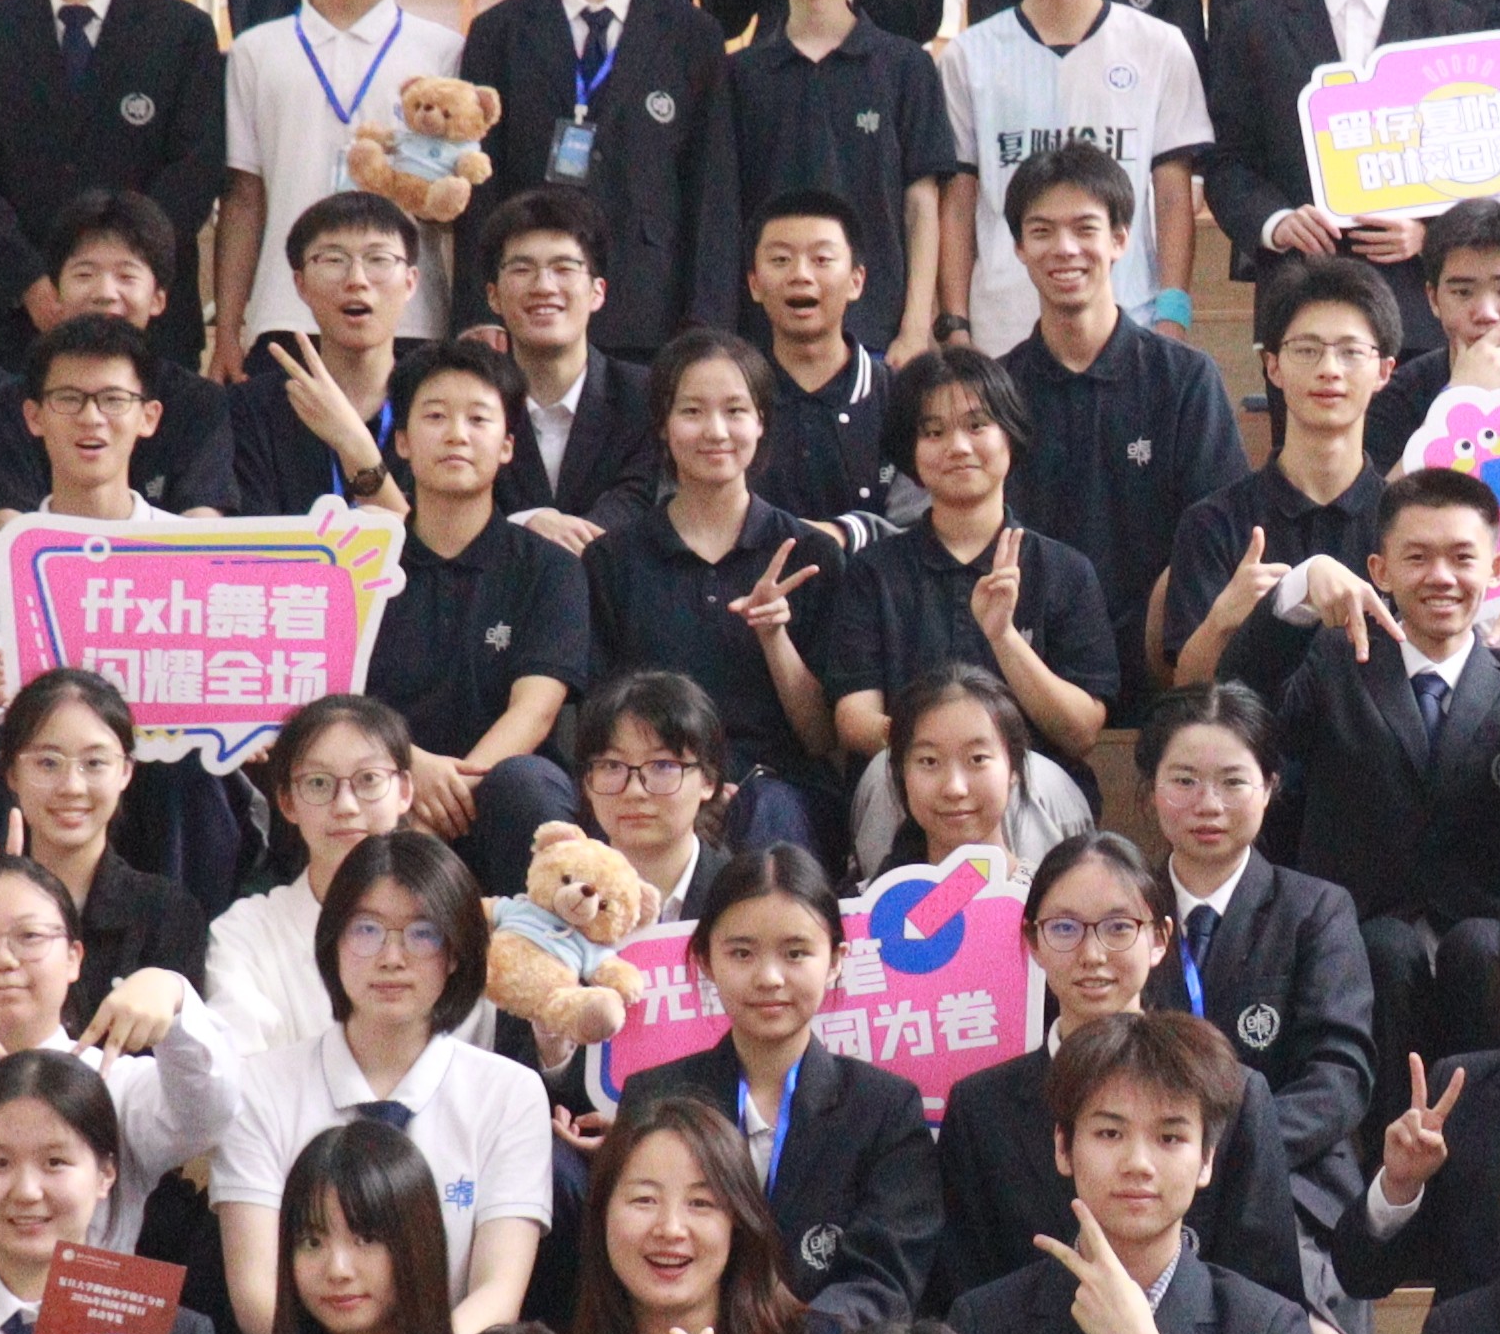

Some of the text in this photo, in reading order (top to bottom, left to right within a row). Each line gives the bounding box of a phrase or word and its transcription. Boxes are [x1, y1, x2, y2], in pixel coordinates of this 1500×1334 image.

[81, 578, 329, 640] ffxh舞者
[82, 647, 329, 705] 闪耀全场
